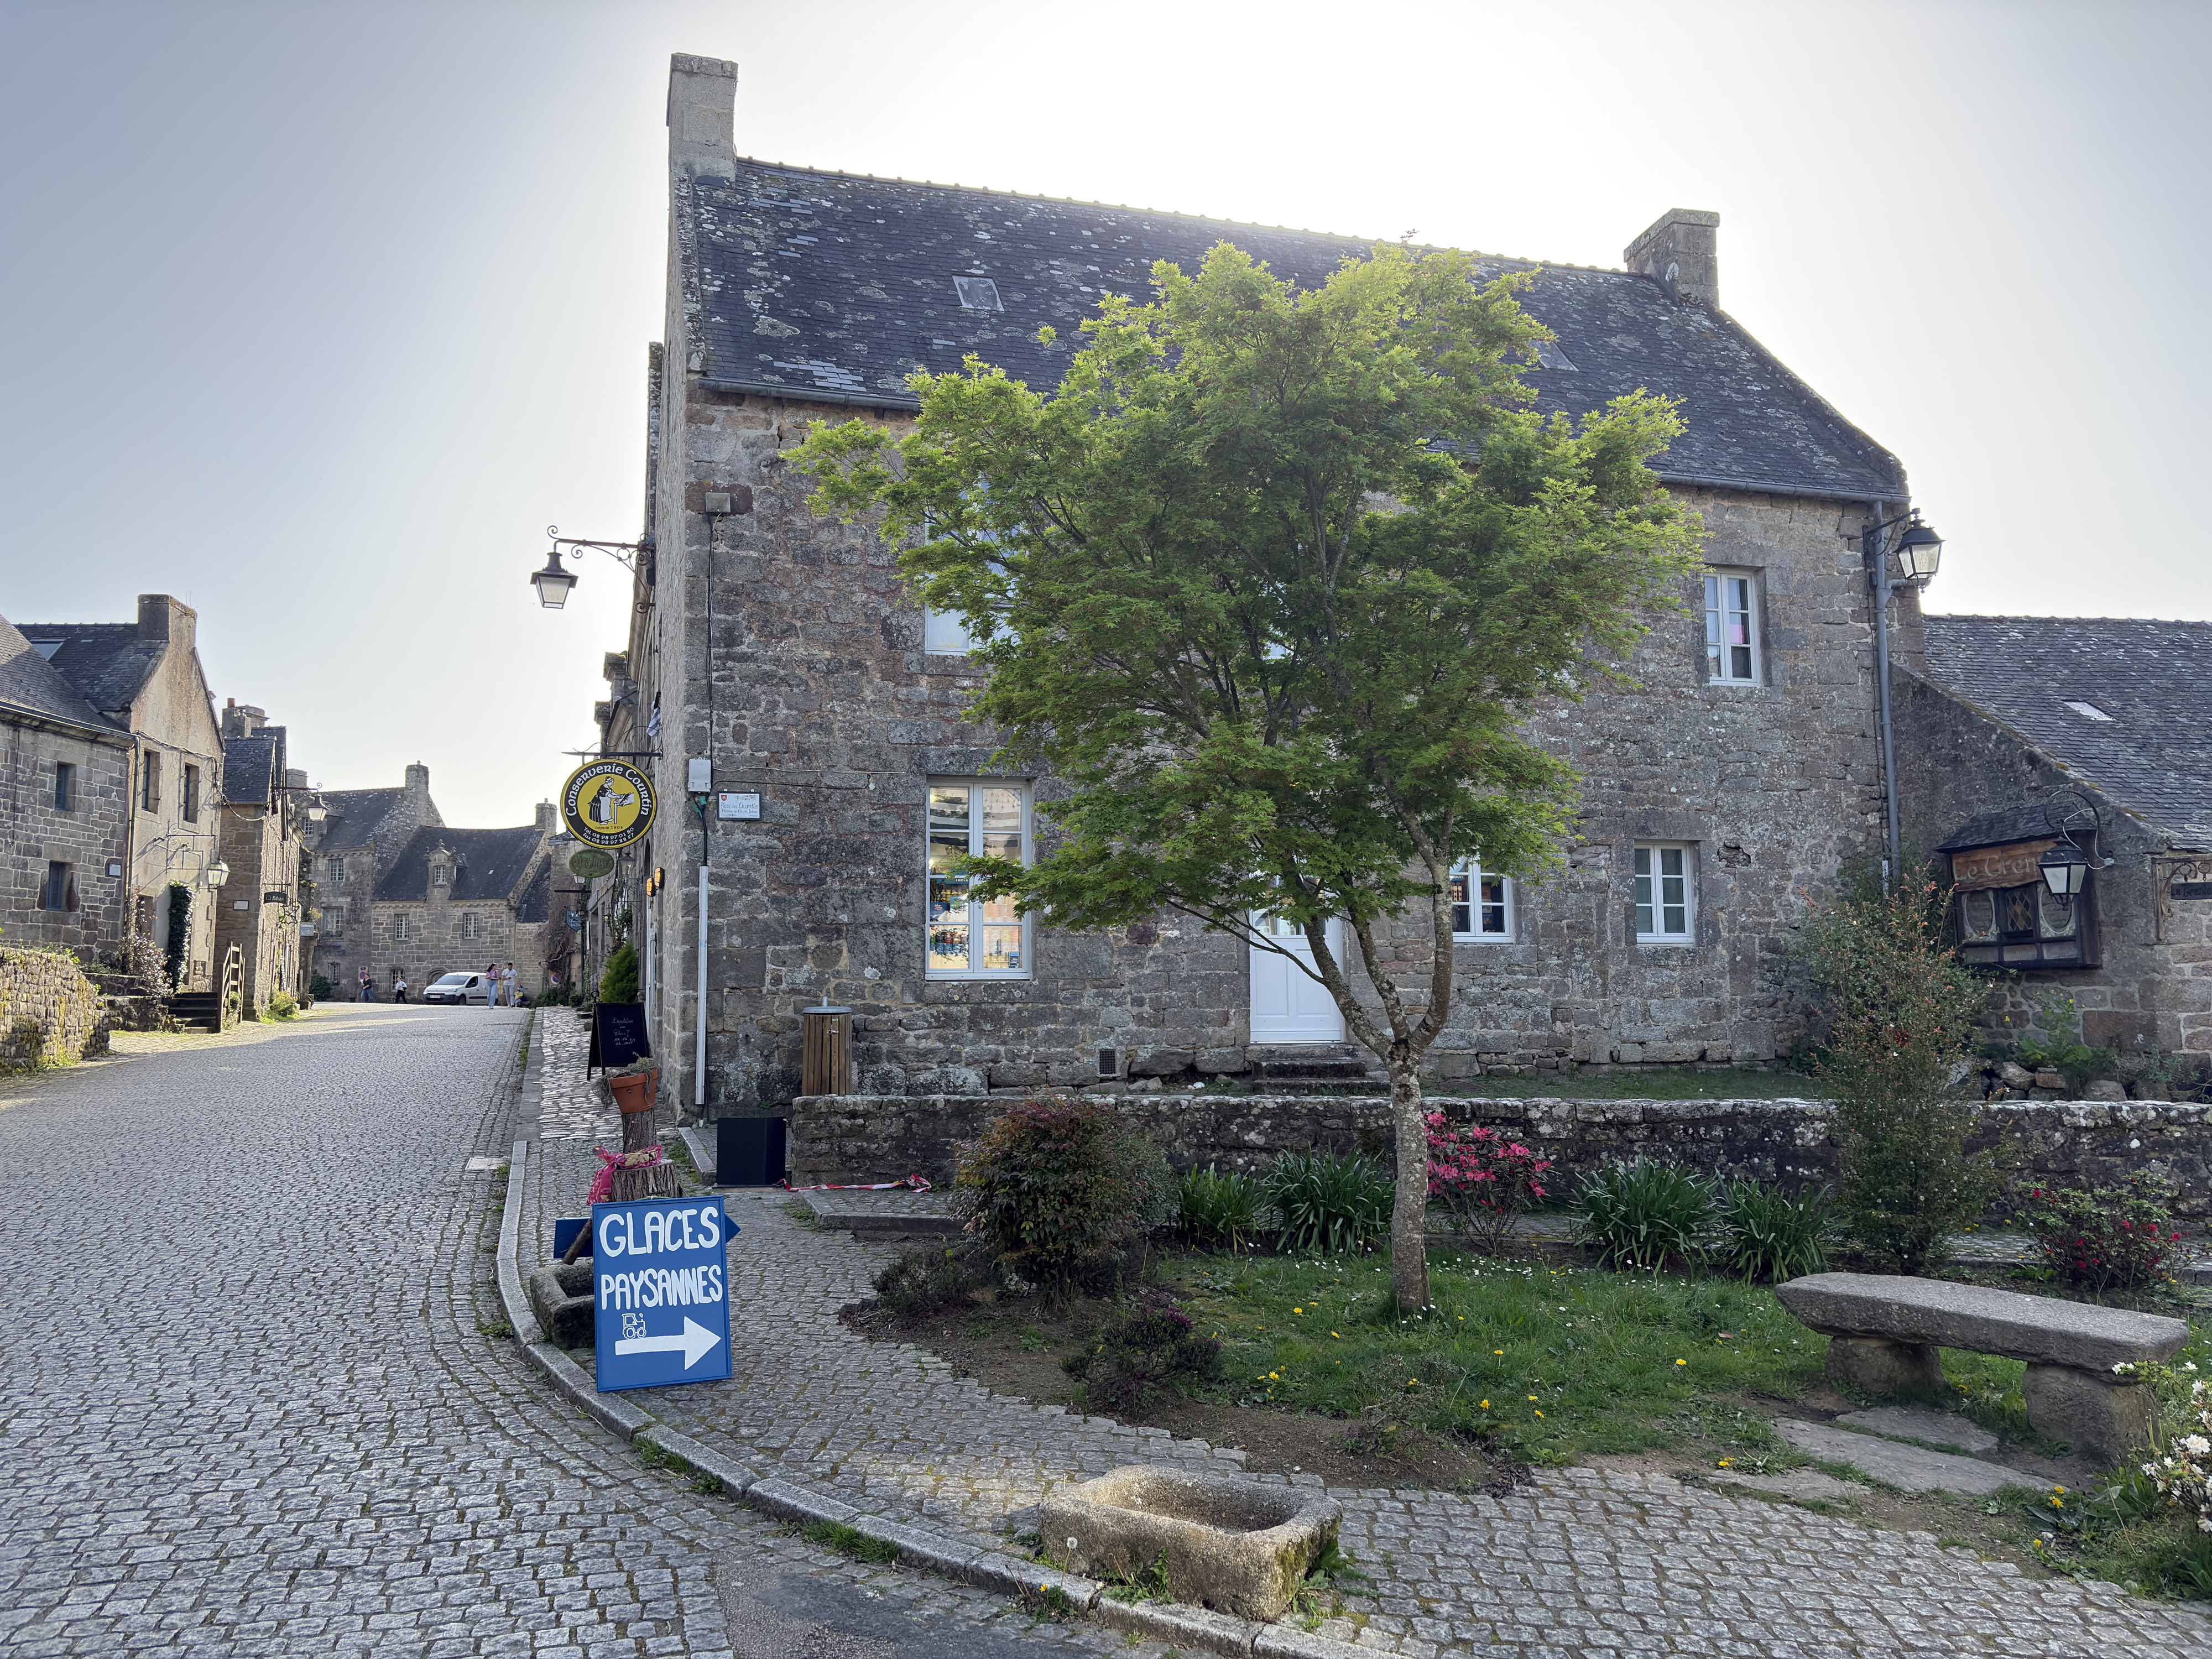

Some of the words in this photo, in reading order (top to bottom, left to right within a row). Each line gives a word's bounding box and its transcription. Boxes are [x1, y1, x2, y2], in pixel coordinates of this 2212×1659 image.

[566, 763, 623, 816] Conserverie
[625, 769, 652, 816] Courtin
[1985, 855, 2039, 877] Gren
[599, 1206, 720, 1258] GLACES
[601, 1264, 723, 1310] PAYSANNES
